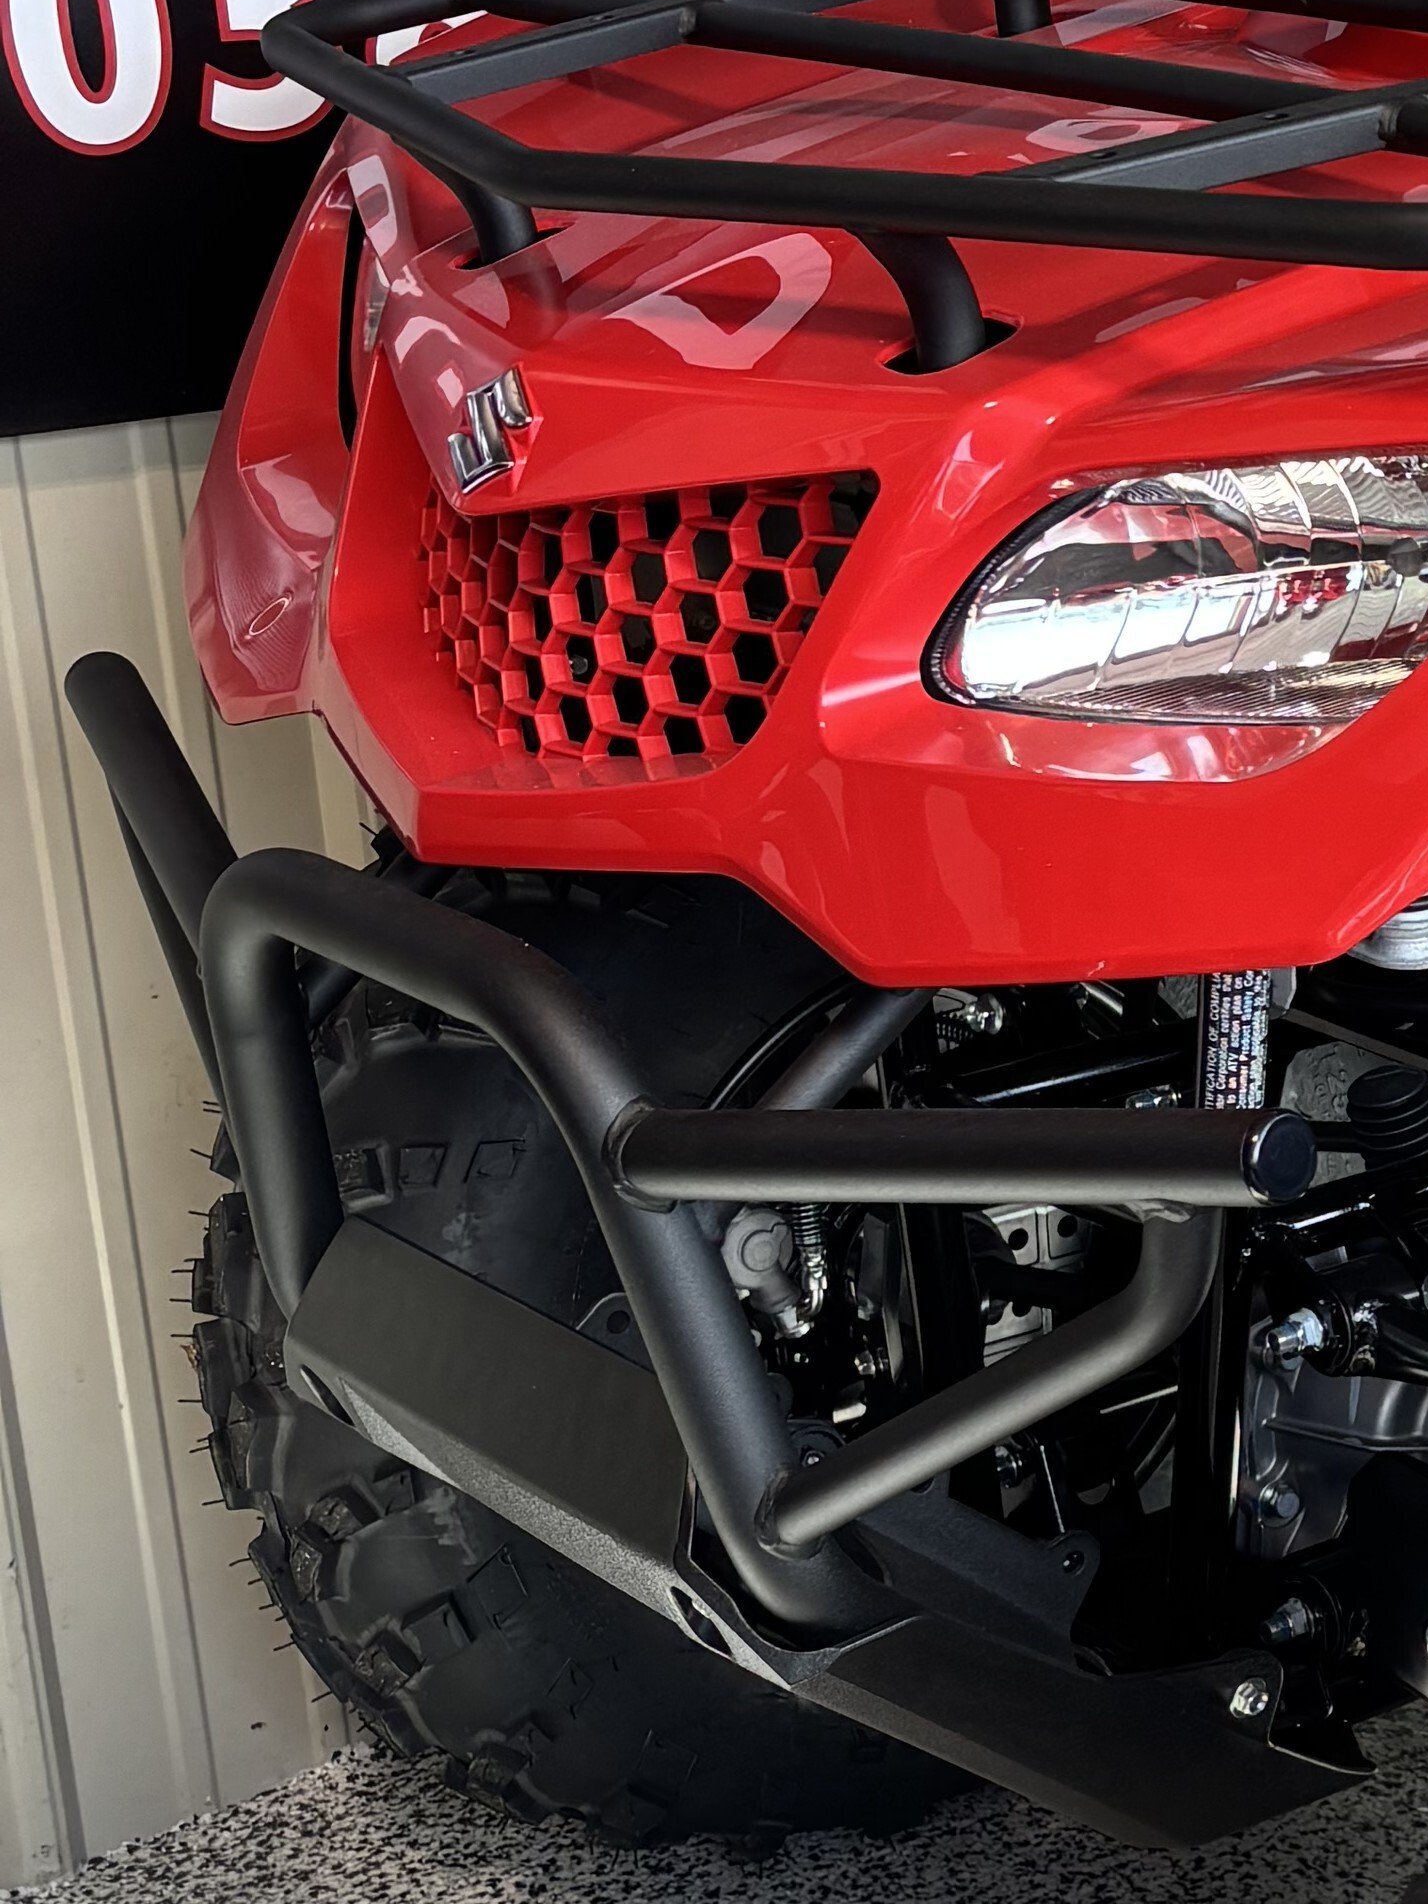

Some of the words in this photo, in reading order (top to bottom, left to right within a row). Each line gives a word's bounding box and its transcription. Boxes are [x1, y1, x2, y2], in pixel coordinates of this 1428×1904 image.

[1210, 972, 1222, 1021] COMPLIA
[1204, 1046, 1218, 1110] TIFICATION
[1228, 1052, 1239, 1072] ATV
